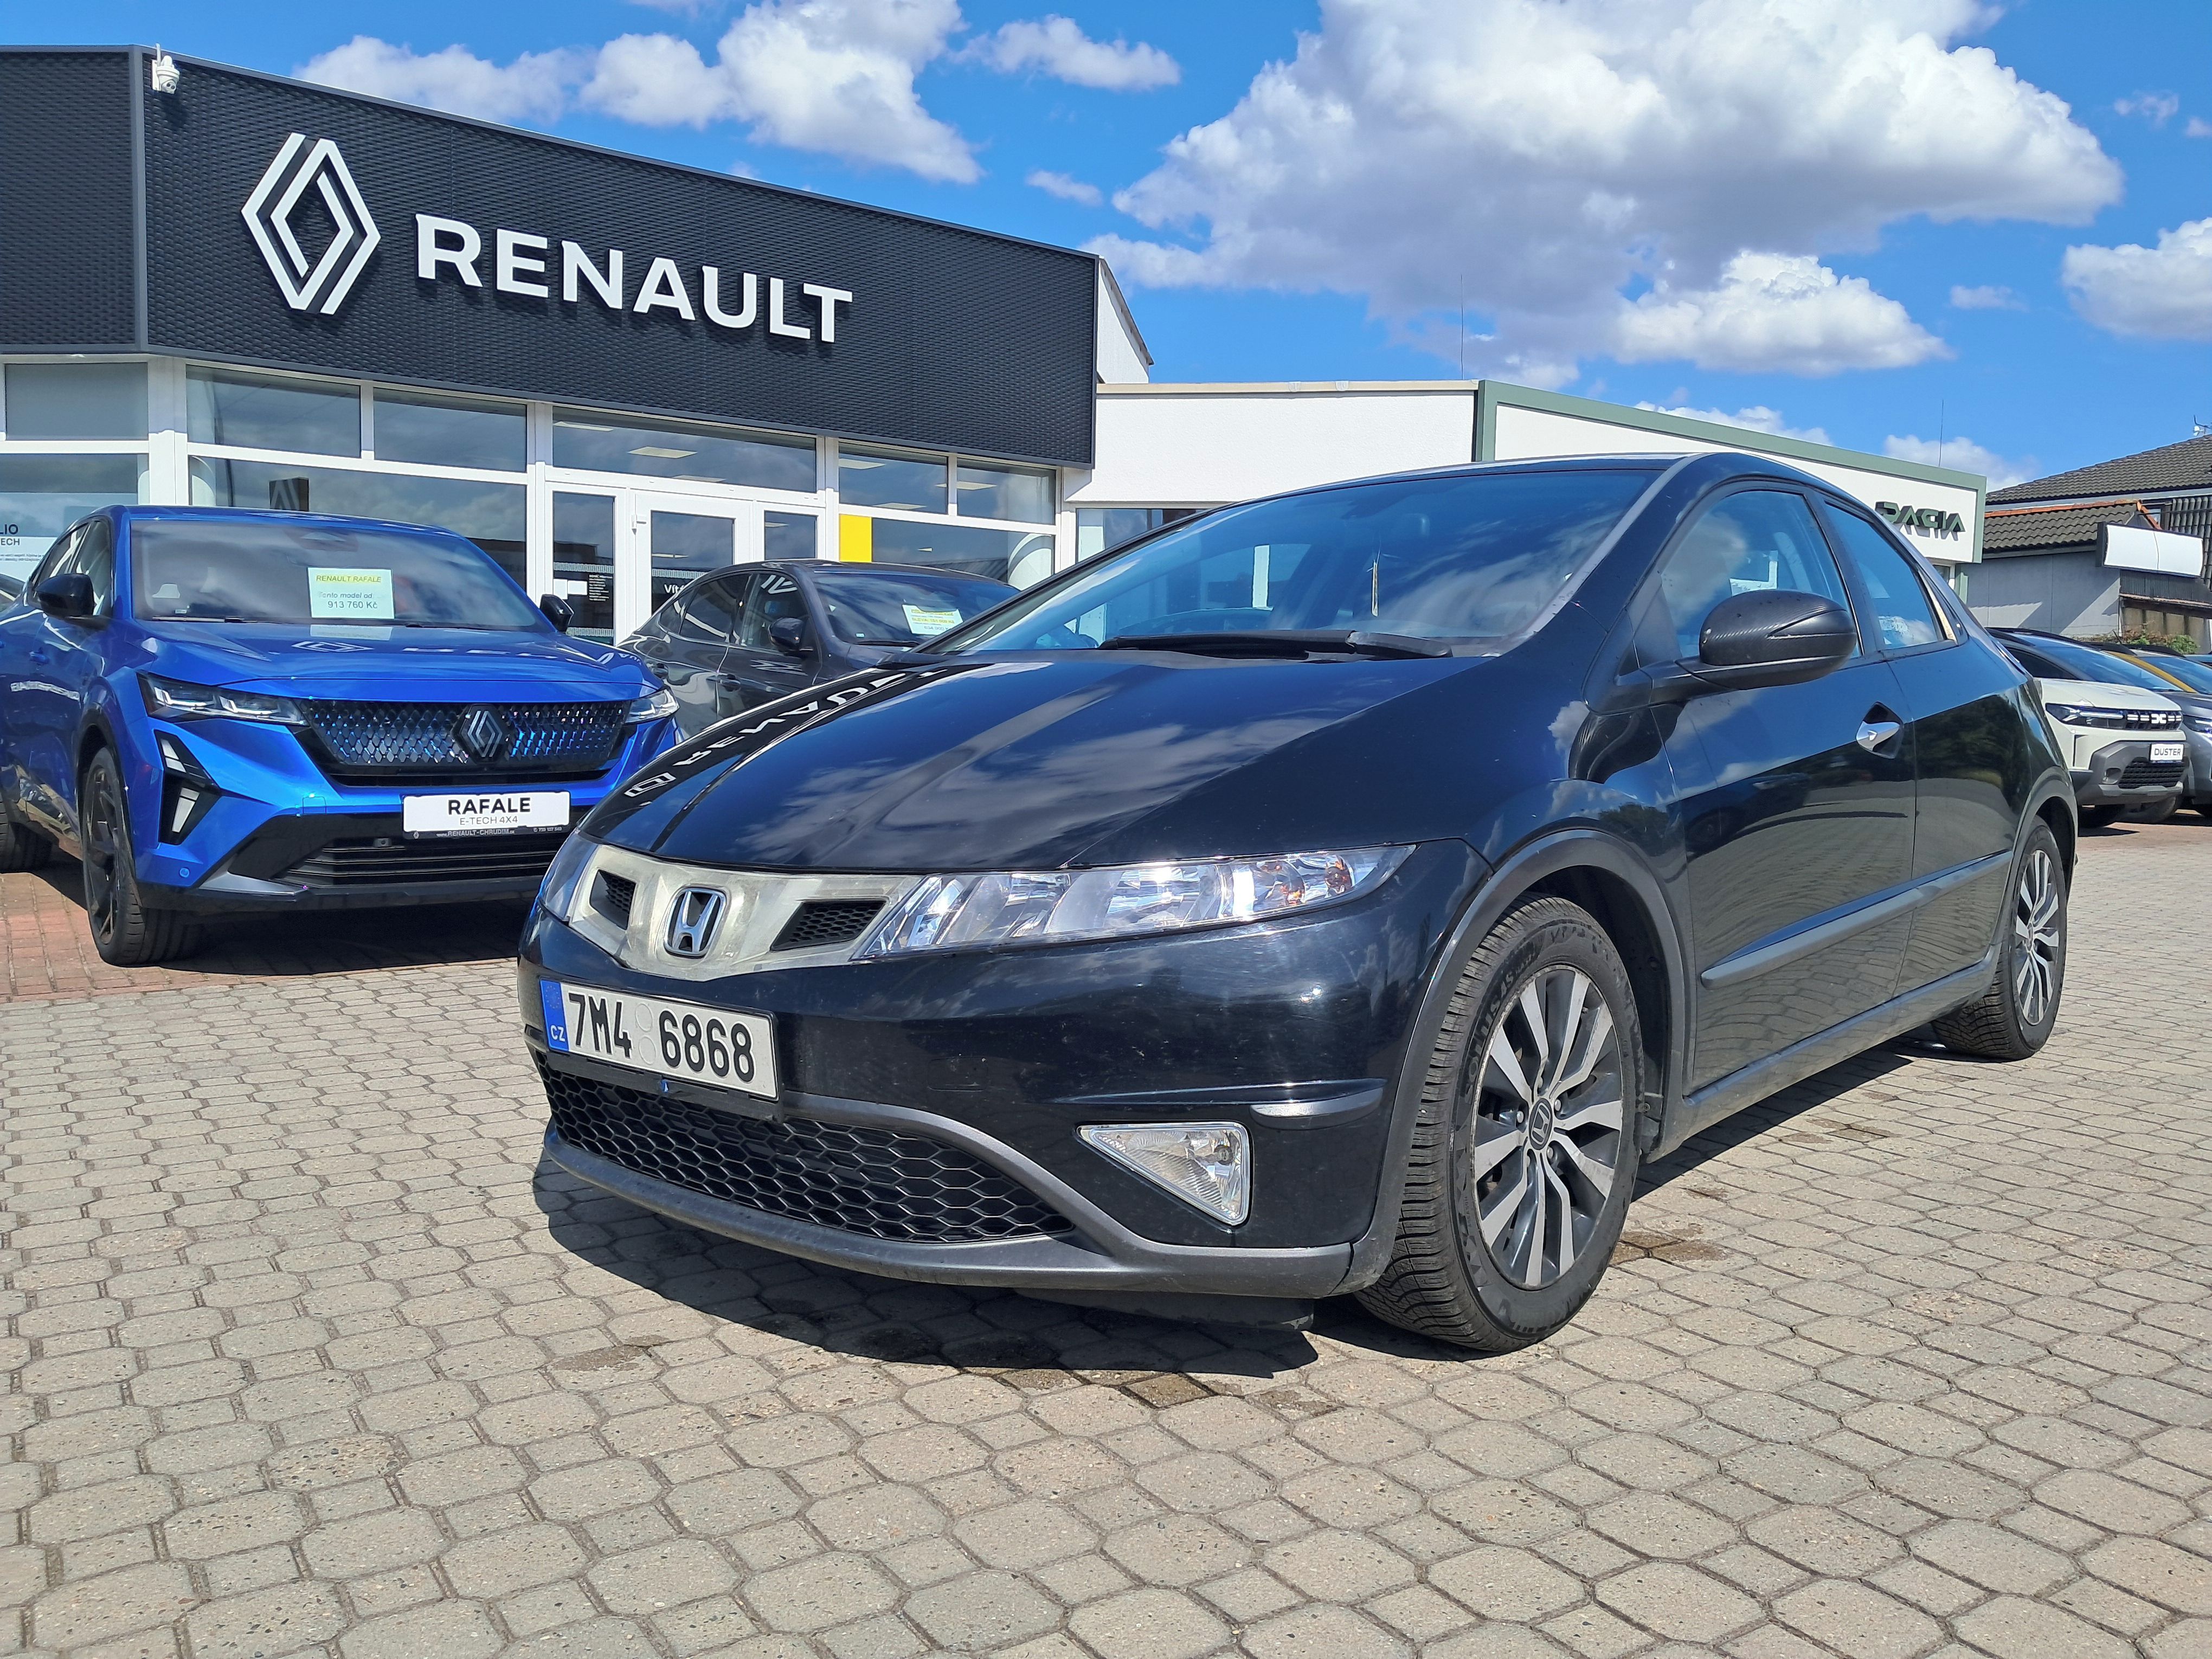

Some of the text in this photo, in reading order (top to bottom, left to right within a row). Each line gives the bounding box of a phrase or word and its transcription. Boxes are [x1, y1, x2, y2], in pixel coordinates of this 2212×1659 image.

[415, 214, 853, 343] RENAULT
[1875, 501, 1965, 532] DACIA
[316, 575, 350, 583] RENAULT
[448, 797, 531, 815] RAFALE
[460, 815, 518, 826] E-TECH 4X4
[551, 1024, 565, 1042] CZ
[568, 992, 755, 1083] 7M4 6868
